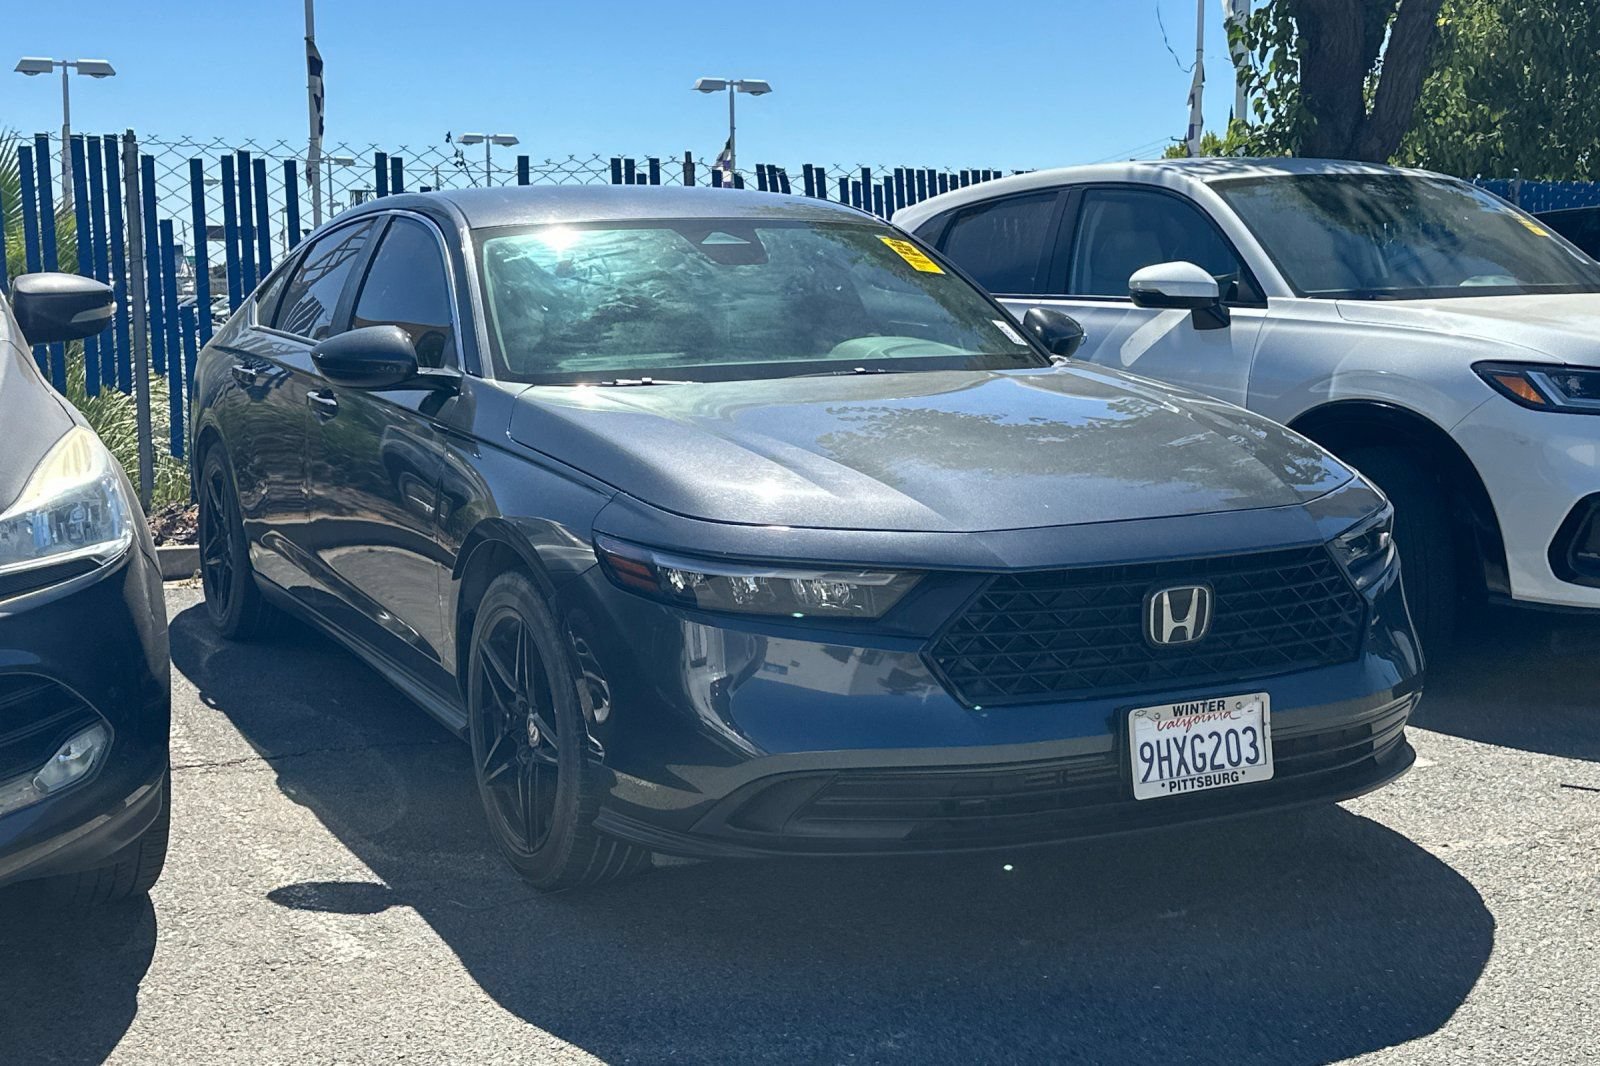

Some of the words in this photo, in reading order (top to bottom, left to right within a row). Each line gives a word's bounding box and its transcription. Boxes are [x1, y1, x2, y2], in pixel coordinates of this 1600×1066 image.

[1172, 700, 1226, 718] WINTER
[1139, 726, 1260, 783] 9HXG203
[1169, 771, 1240, 793] PITTSBURG
